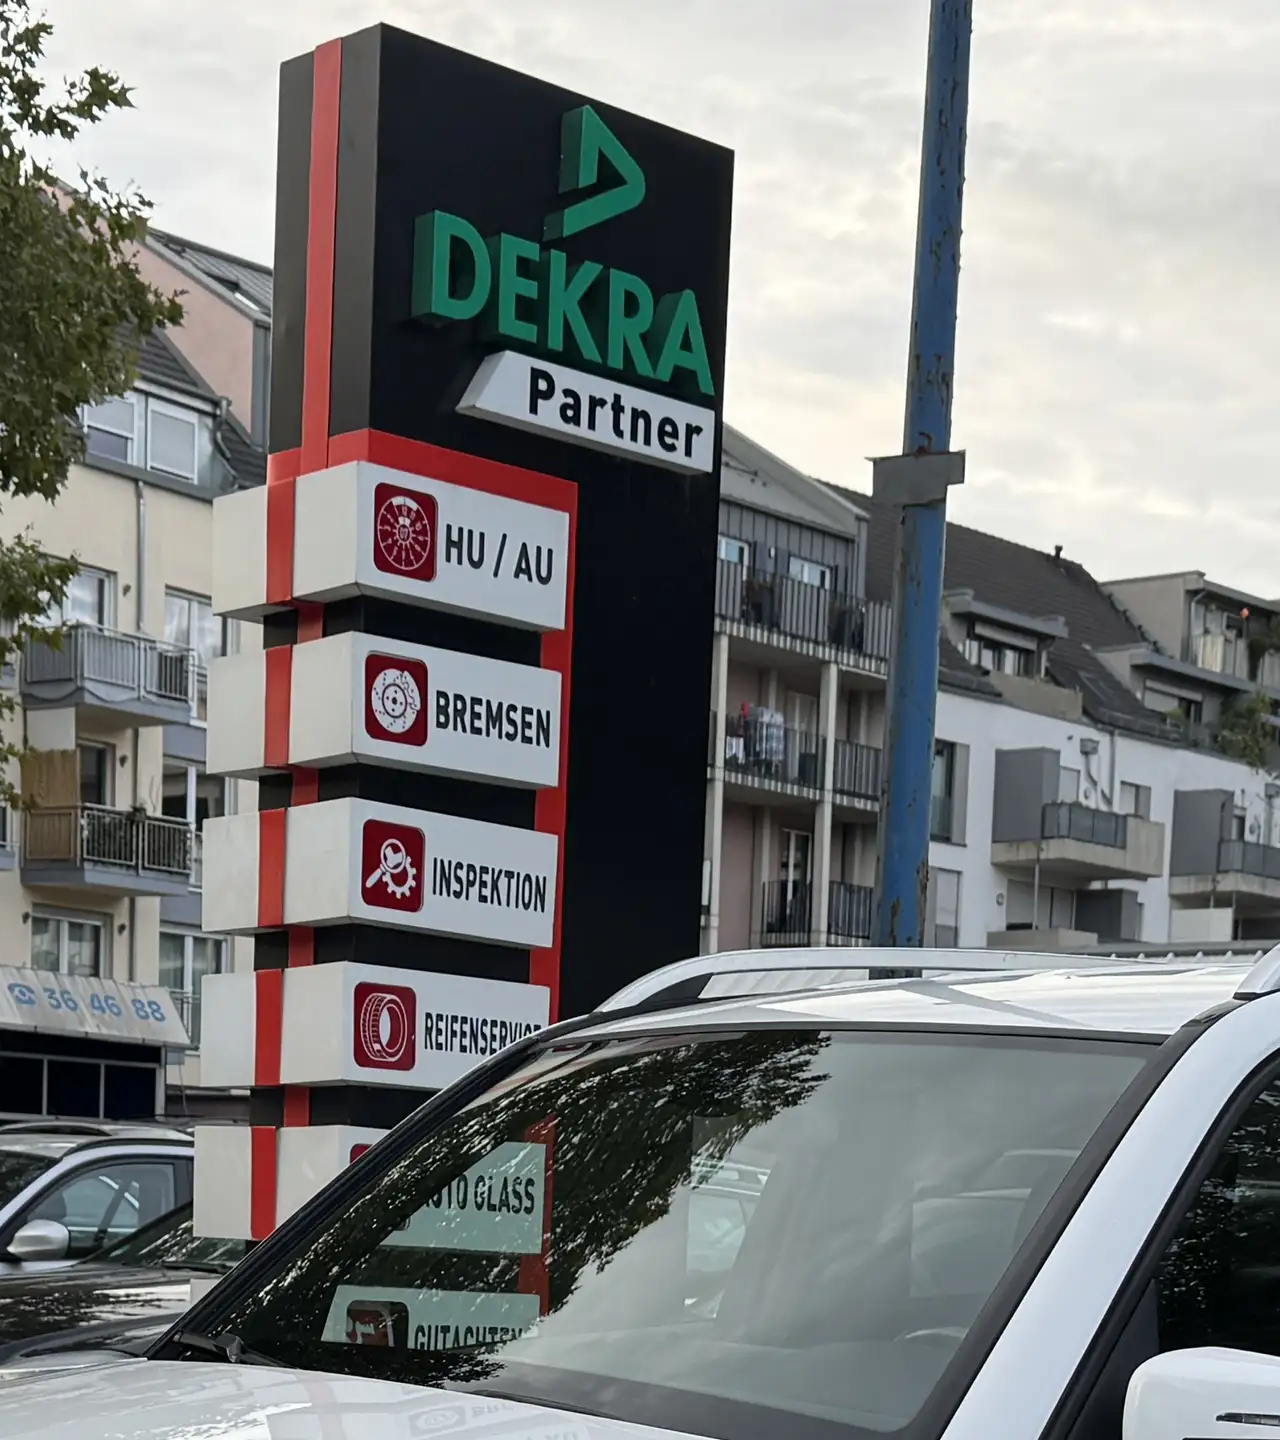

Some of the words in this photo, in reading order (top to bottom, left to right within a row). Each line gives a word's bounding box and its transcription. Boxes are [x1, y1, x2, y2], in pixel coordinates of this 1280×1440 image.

[420, 209, 716, 397] DEKRA
[528, 366, 704, 459] Partner
[445, 523, 486, 570] HU
[492, 532, 508, 579] /
[513, 541, 554, 586] AU
[434, 690, 552, 749] BREMSEN
[431, 856, 547, 914] INSPEKTION
[42, 986, 79, 1012] 36
[89, 993, 122, 1017] 46
[131, 998, 166, 1022] 88
[424, 1012, 542, 1056] REIFENSERVI
[473, 1175, 536, 1215] GLASS
